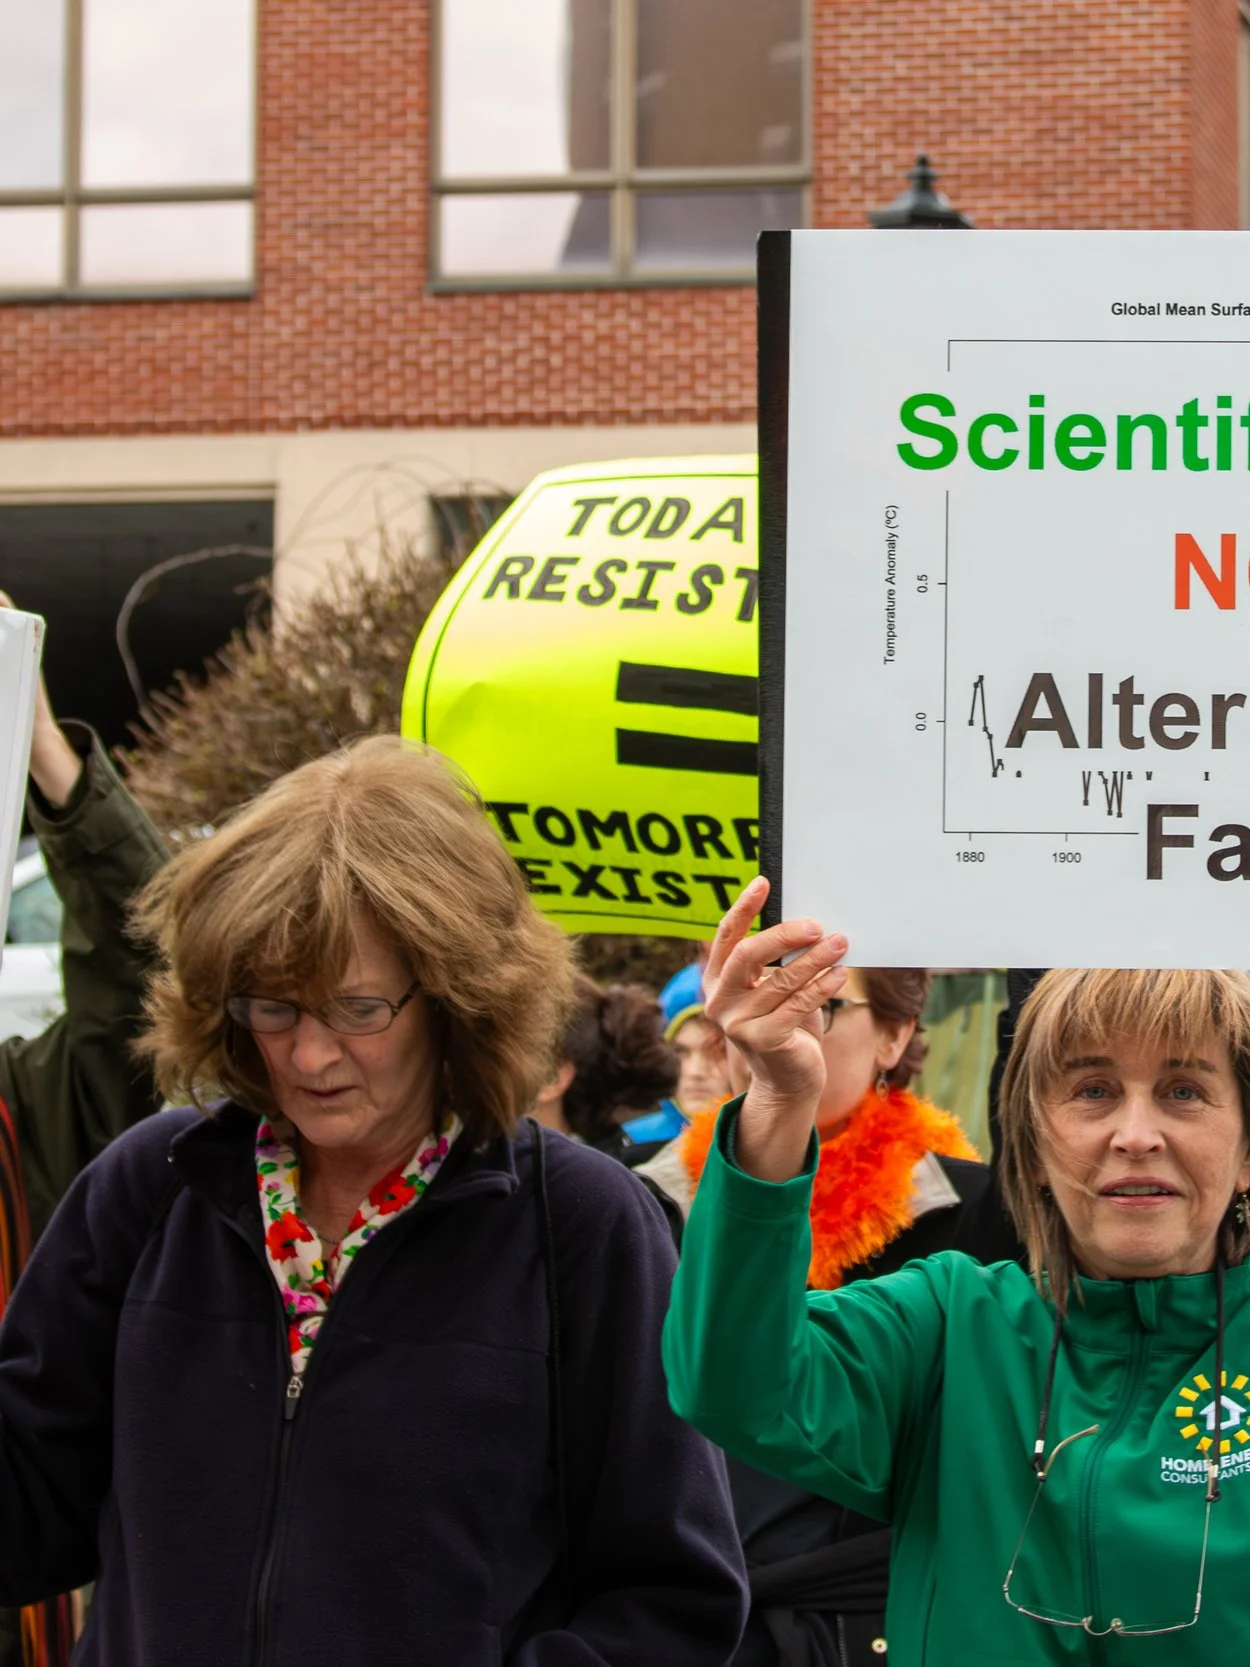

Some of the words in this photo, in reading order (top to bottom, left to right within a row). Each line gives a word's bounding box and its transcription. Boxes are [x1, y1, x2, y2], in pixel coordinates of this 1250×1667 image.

[1111, 302, 1160, 316] Global
[1166, 302, 1206, 316] Mean
[566, 495, 745, 544] TODA
[884, 532, 900, 585] Anomaly
[916, 574, 929, 594] 0.5
[883, 588, 898, 665] Temperature
[914, 712, 927, 732] 0.0
[955, 851, 986, 864] 1880
[1052, 852, 1082, 864] 1900
[514, 857, 742, 912] EXIST
